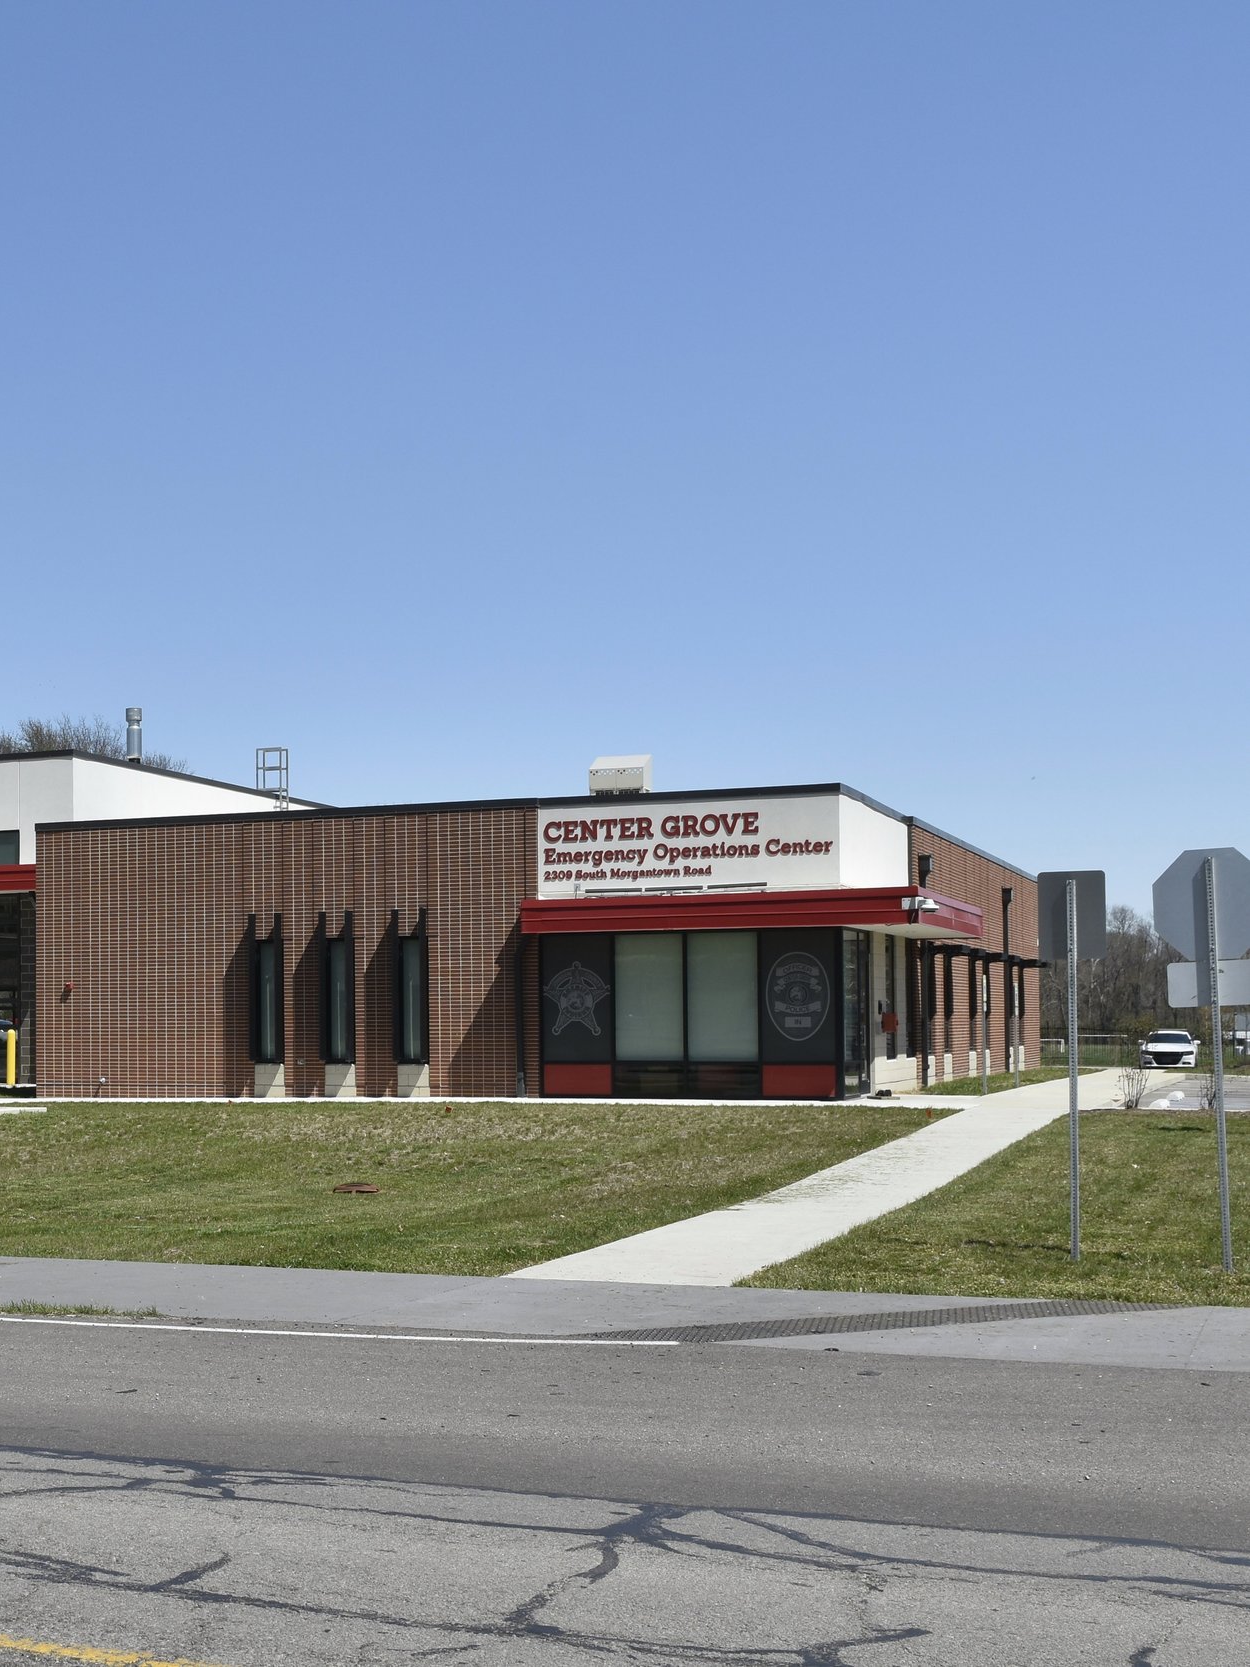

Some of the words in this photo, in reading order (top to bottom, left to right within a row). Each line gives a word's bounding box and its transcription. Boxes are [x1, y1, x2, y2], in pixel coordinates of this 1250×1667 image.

[543, 816, 654, 843] CENTER
[660, 812, 759, 839] GROVE
[543, 847, 648, 868] Emergency
[653, 841, 760, 865] Operations
[765, 838, 833, 857] Center
[543, 869, 573, 881] 2309
[574, 868, 607, 881] South
[610, 866, 680, 882] Morgantown
[683, 865, 712, 877] Road
